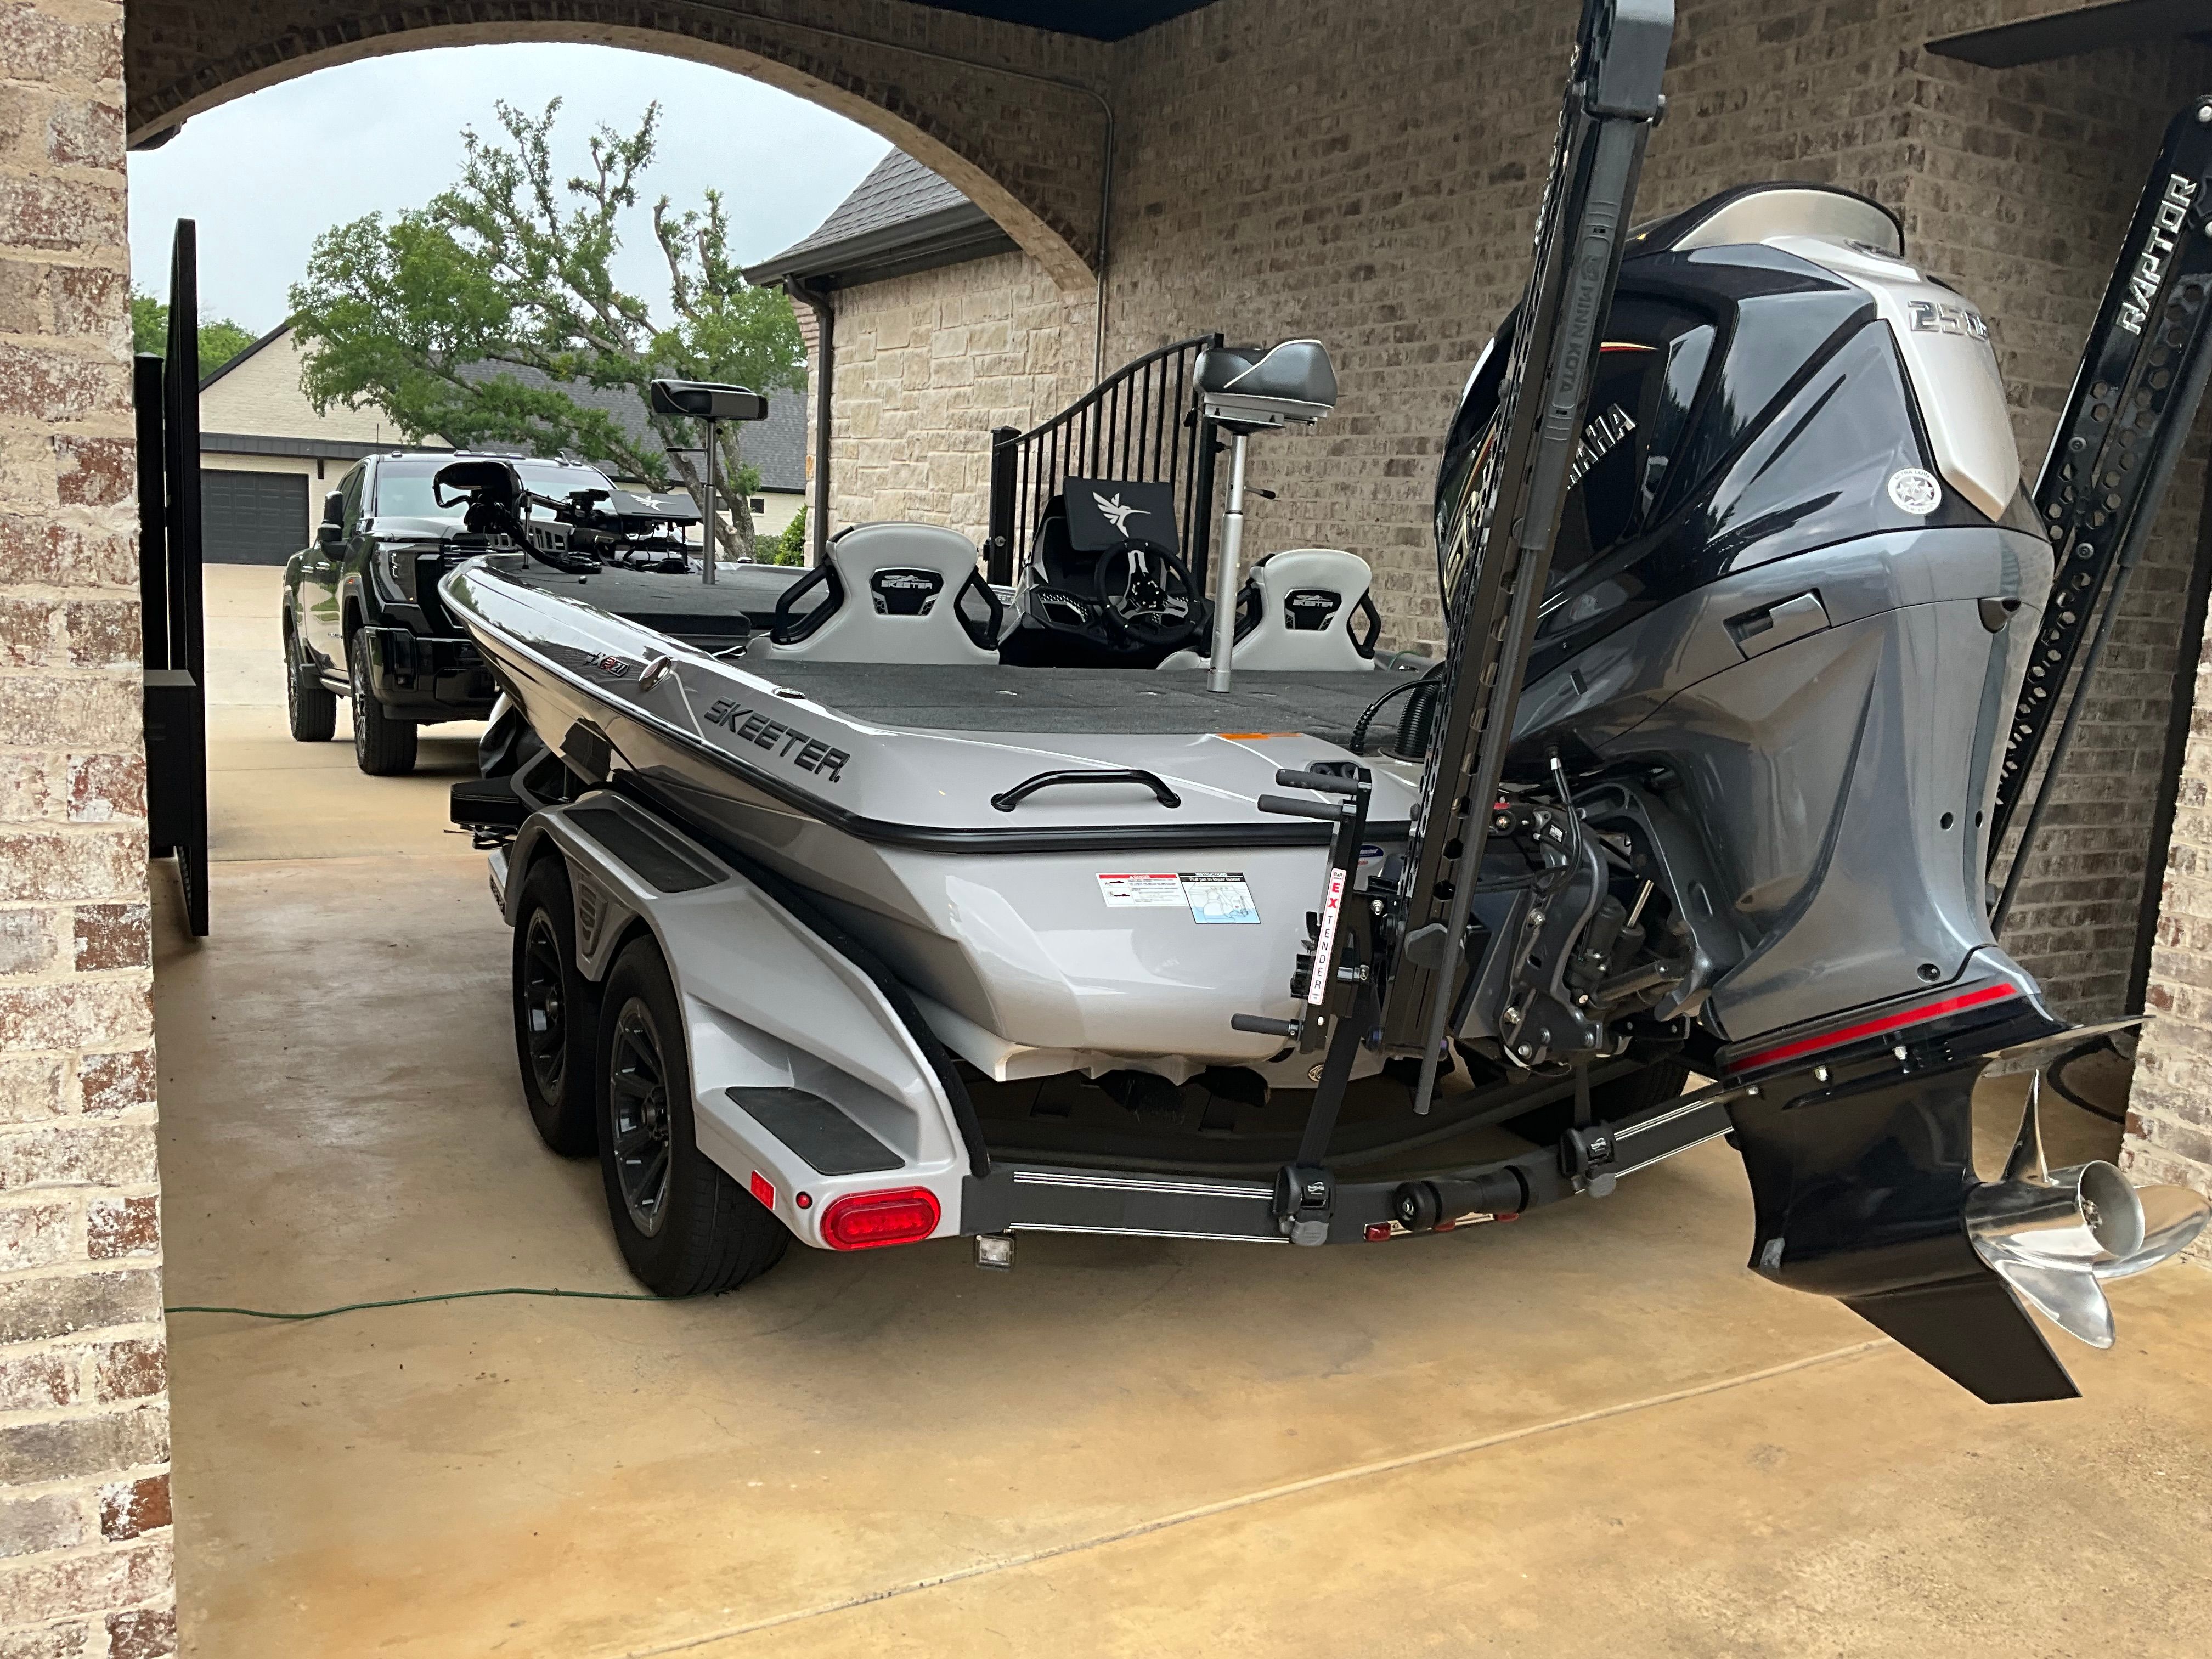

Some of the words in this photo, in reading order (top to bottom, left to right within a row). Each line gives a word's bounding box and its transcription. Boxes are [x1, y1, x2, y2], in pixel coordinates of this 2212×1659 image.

[2115, 173, 2197, 335] RAPTOR
[1573, 285, 1595, 338] MINN
[1559, 342, 1582, 393] KOTA
[881, 580, 933, 589] SKEETER
[1293, 599, 1333, 607] SKEETER
[704, 696, 850, 782] SKEETER
